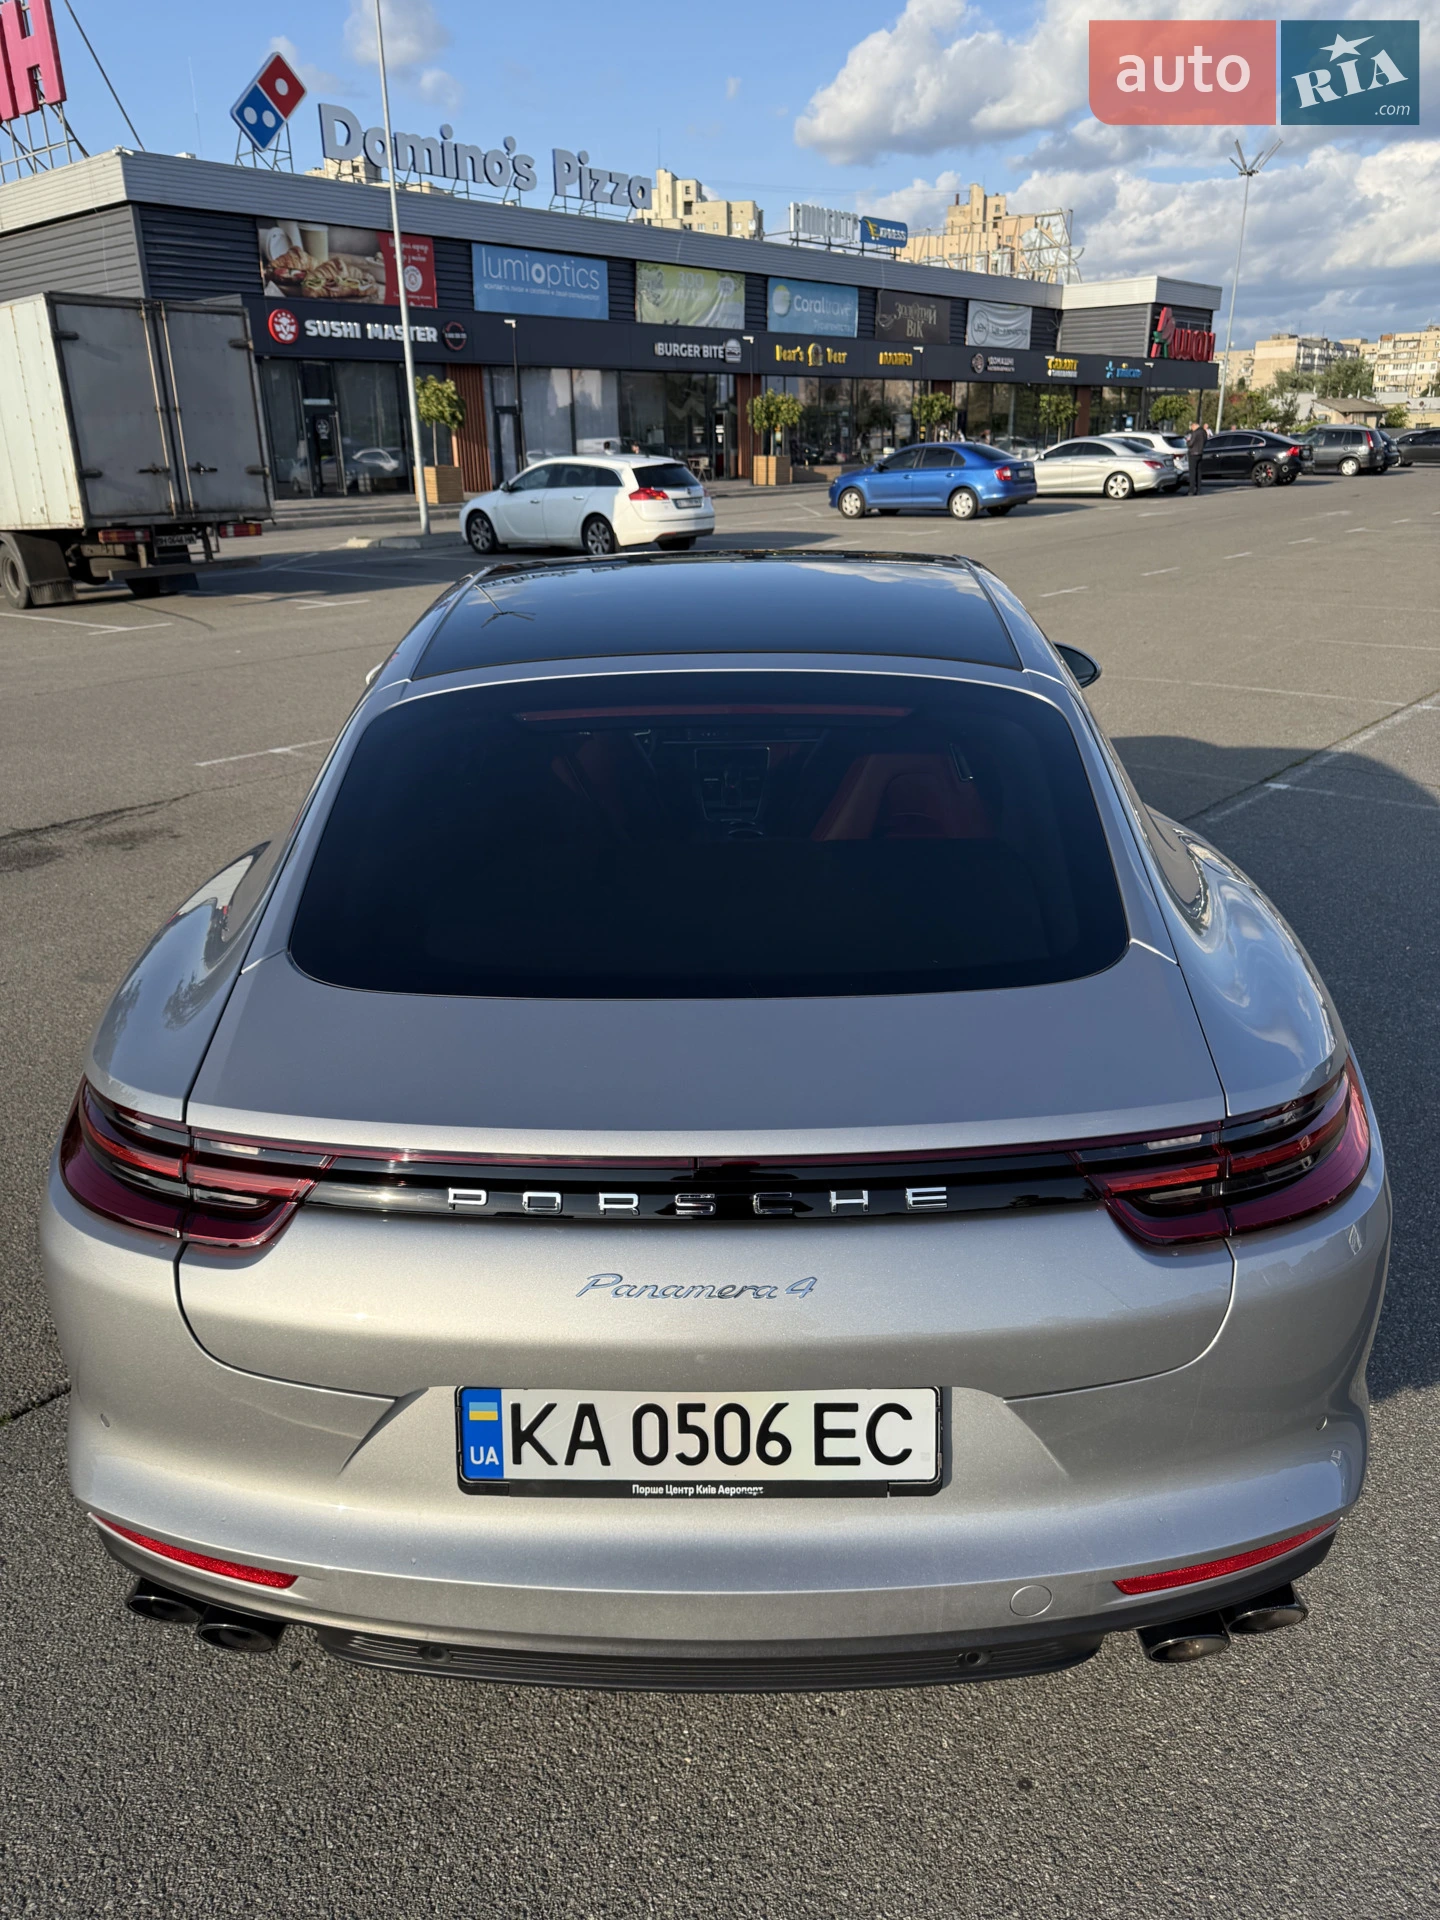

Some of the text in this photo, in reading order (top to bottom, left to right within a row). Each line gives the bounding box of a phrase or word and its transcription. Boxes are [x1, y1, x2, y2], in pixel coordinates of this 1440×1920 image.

[317, 102, 652, 210] Domino's Pizza
[481, 247, 600, 291] lumioptics
[304, 319, 438, 342] SUSHI MASTER
[654, 341, 725, 359] BURGER BITE
[447, 1186, 949, 1216] PORSCHE
[575, 1273, 818, 1300] Panamera 4
[470, 1401, 913, 1467] UA KA 0506 EC
[632, 1484, 664, 1497] Порше
[665, 1484, 695, 1497] Центр
[696, 1484, 717, 1495] Київ
